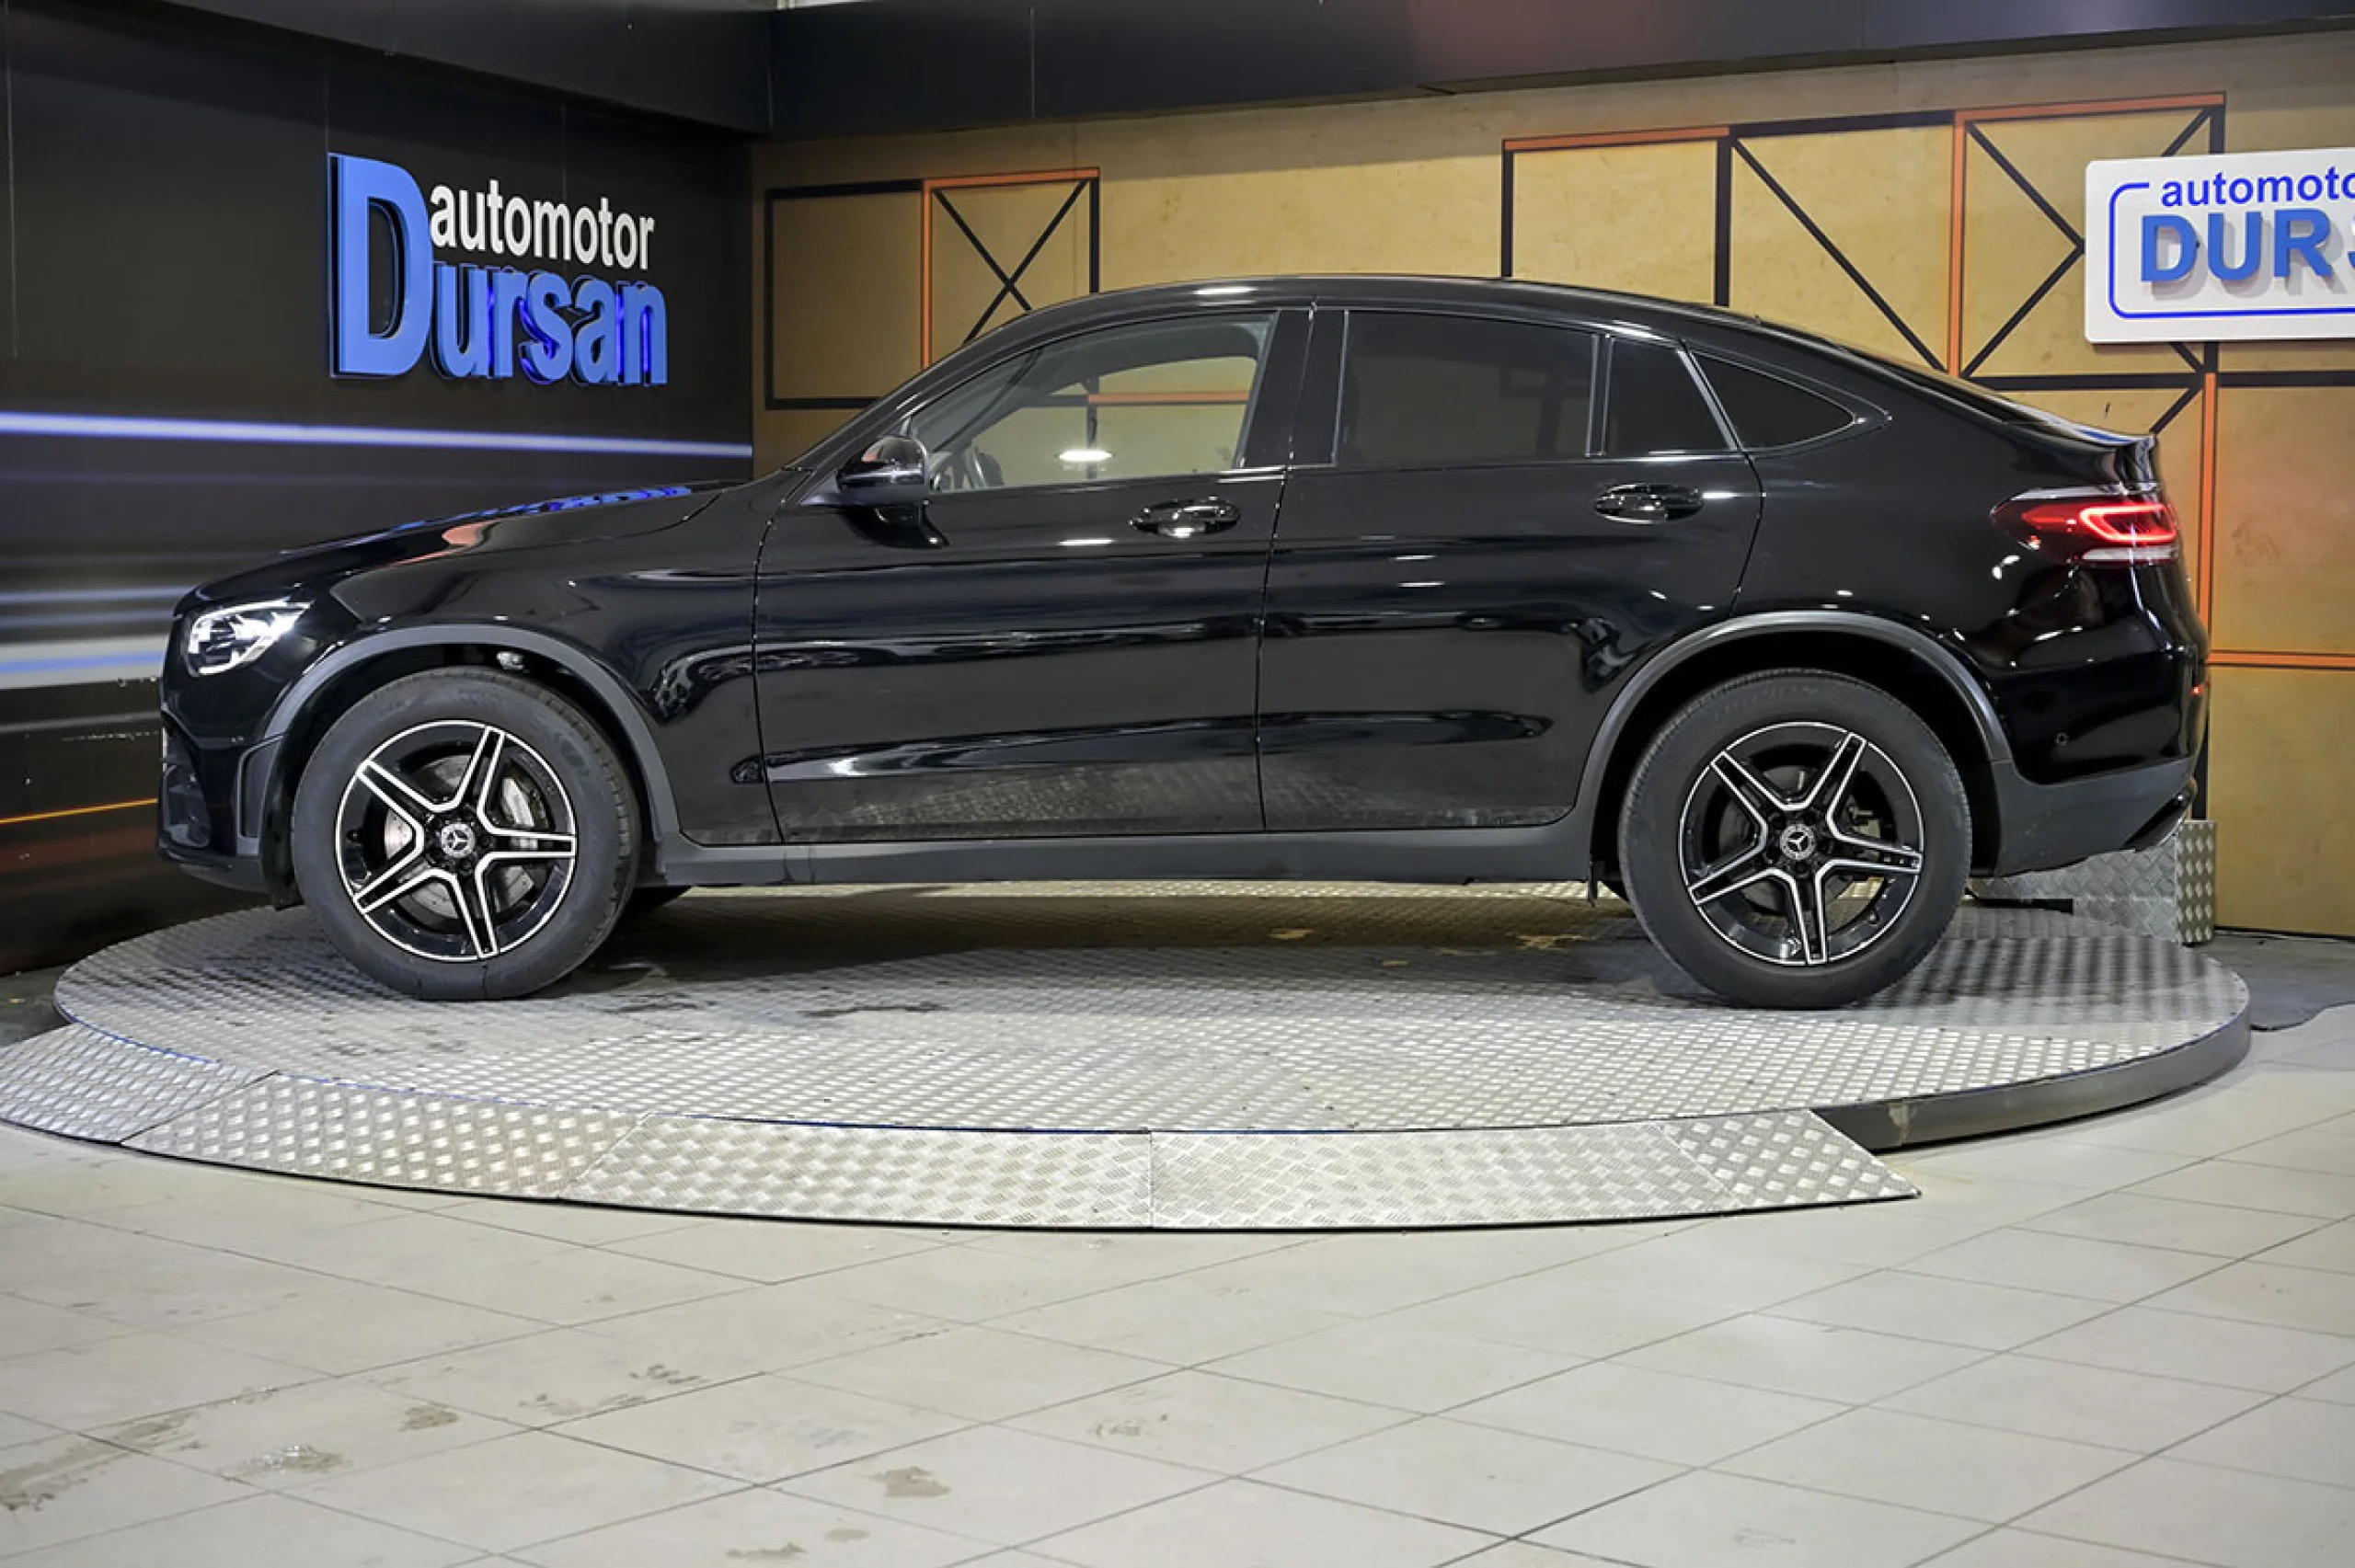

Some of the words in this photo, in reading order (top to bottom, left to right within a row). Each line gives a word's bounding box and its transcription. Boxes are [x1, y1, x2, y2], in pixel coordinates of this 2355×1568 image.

[327, 152, 668, 386] Dursan
[430, 178, 655, 269] automotor
[2141, 208, 2355, 282] DUR
